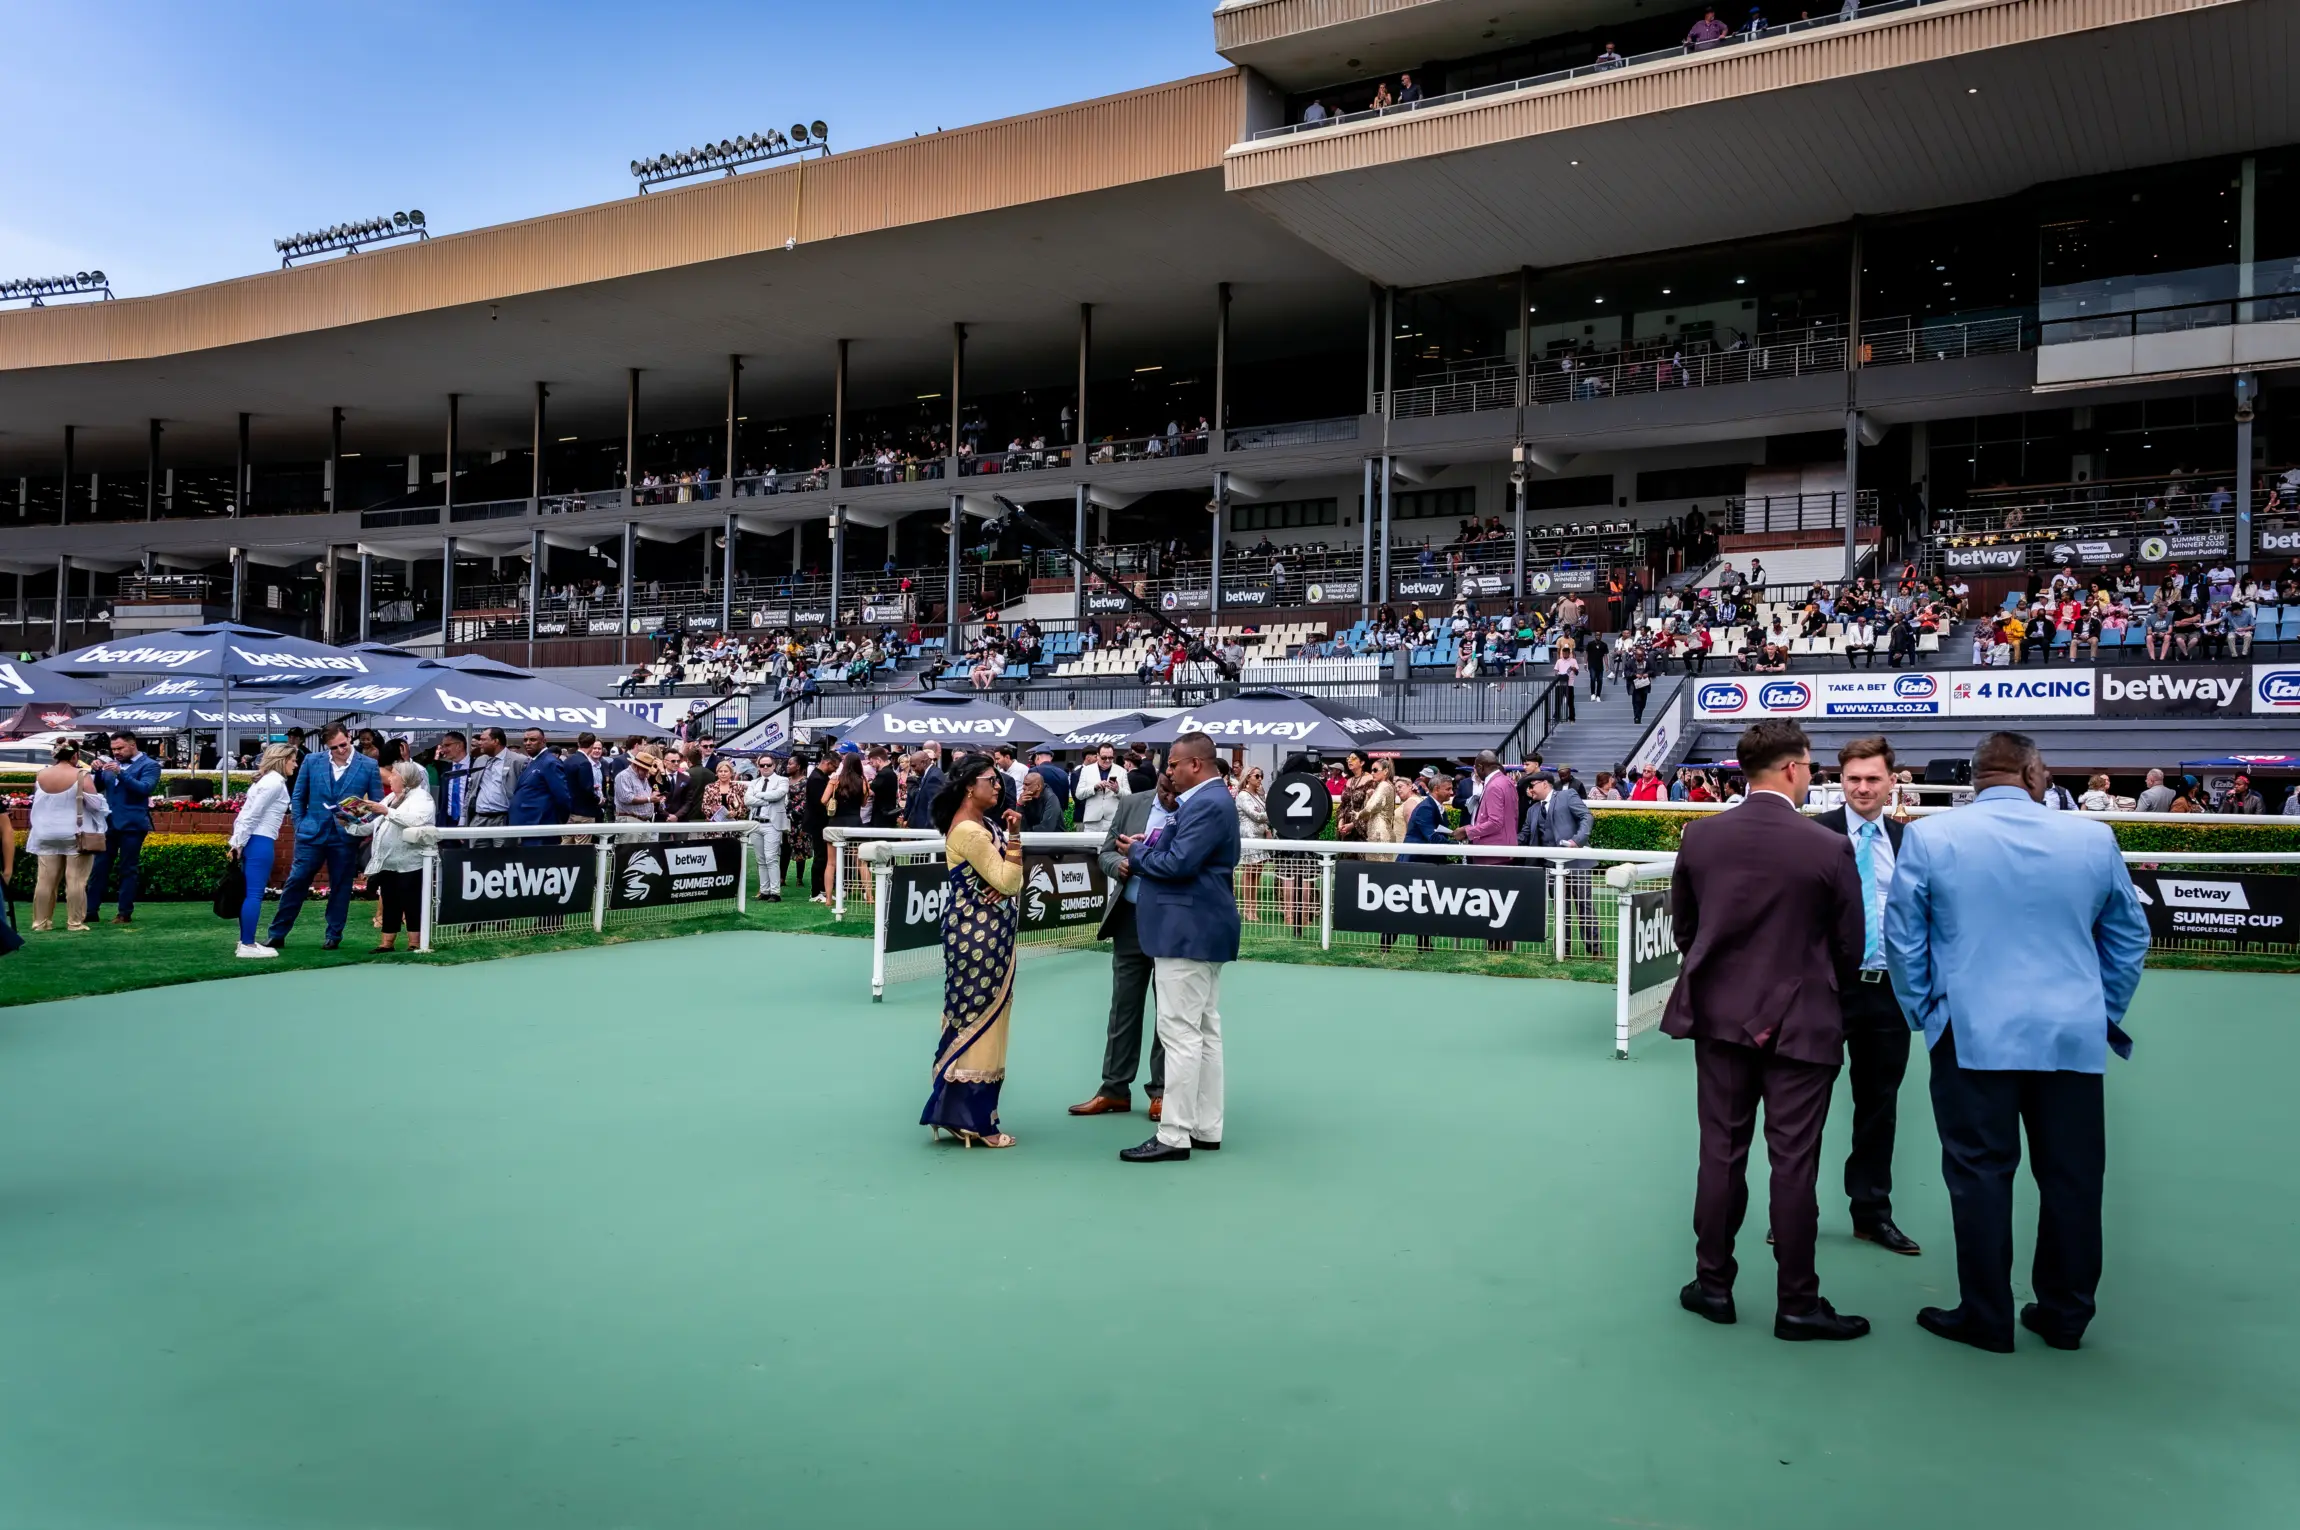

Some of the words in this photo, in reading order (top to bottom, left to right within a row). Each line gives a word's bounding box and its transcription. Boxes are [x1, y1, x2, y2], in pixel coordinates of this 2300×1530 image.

[2171, 536, 2206, 544] SUMMER
[1947, 550, 2022, 567] betway
[1225, 591, 1265, 603] betway
[1400, 583, 1444, 595] betway
[1089, 597, 1126, 610] betway
[688, 615, 717, 627] betway
[795, 612, 825, 623] betway
[538, 623, 565, 634] betway
[589, 621, 620, 633] betway
[75, 646, 212, 668] betway
[230, 645, 369, 672] betway
[310, 683, 412, 705] betway
[1828, 684, 1855, 692] TAKE
[1867, 683, 1886, 691] BET
[1900, 681, 1932, 693] tab
[1977, 682, 1992, 698] 4
[1998, 680, 2090, 698] RACING
[2102, 673, 2243, 706] betway
[2269, 679, 2300, 698] ta
[1705, 690, 1742, 706] tab
[1767, 689, 1805, 704] tab
[96, 708, 182, 723] betway
[435, 687, 606, 728] betway
[1834, 703, 1931, 713] WWW.TAB.CO.ZA
[883, 714, 1015, 737] betway
[1176, 716, 1320, 740] betway
[1328, 716, 1395, 735] betway
[1286, 782, 1313, 818] 2
[675, 854, 707, 866] betway
[462, 861, 580, 904] betway
[672, 876, 714, 890] SUMMER
[715, 874, 734, 887] CUP
[1061, 870, 1084, 885] betway
[1357, 872, 1519, 929] betway
[2174, 886, 2231, 901] betway
[905, 880, 952, 925] bet
[1060, 896, 1090, 911] SUMMER
[1090, 895, 1104, 908] CUP
[2173, 911, 2246, 926] SUMMER
[2248, 915, 2283, 927] CUP
[1635, 906, 1683, 965] betw
